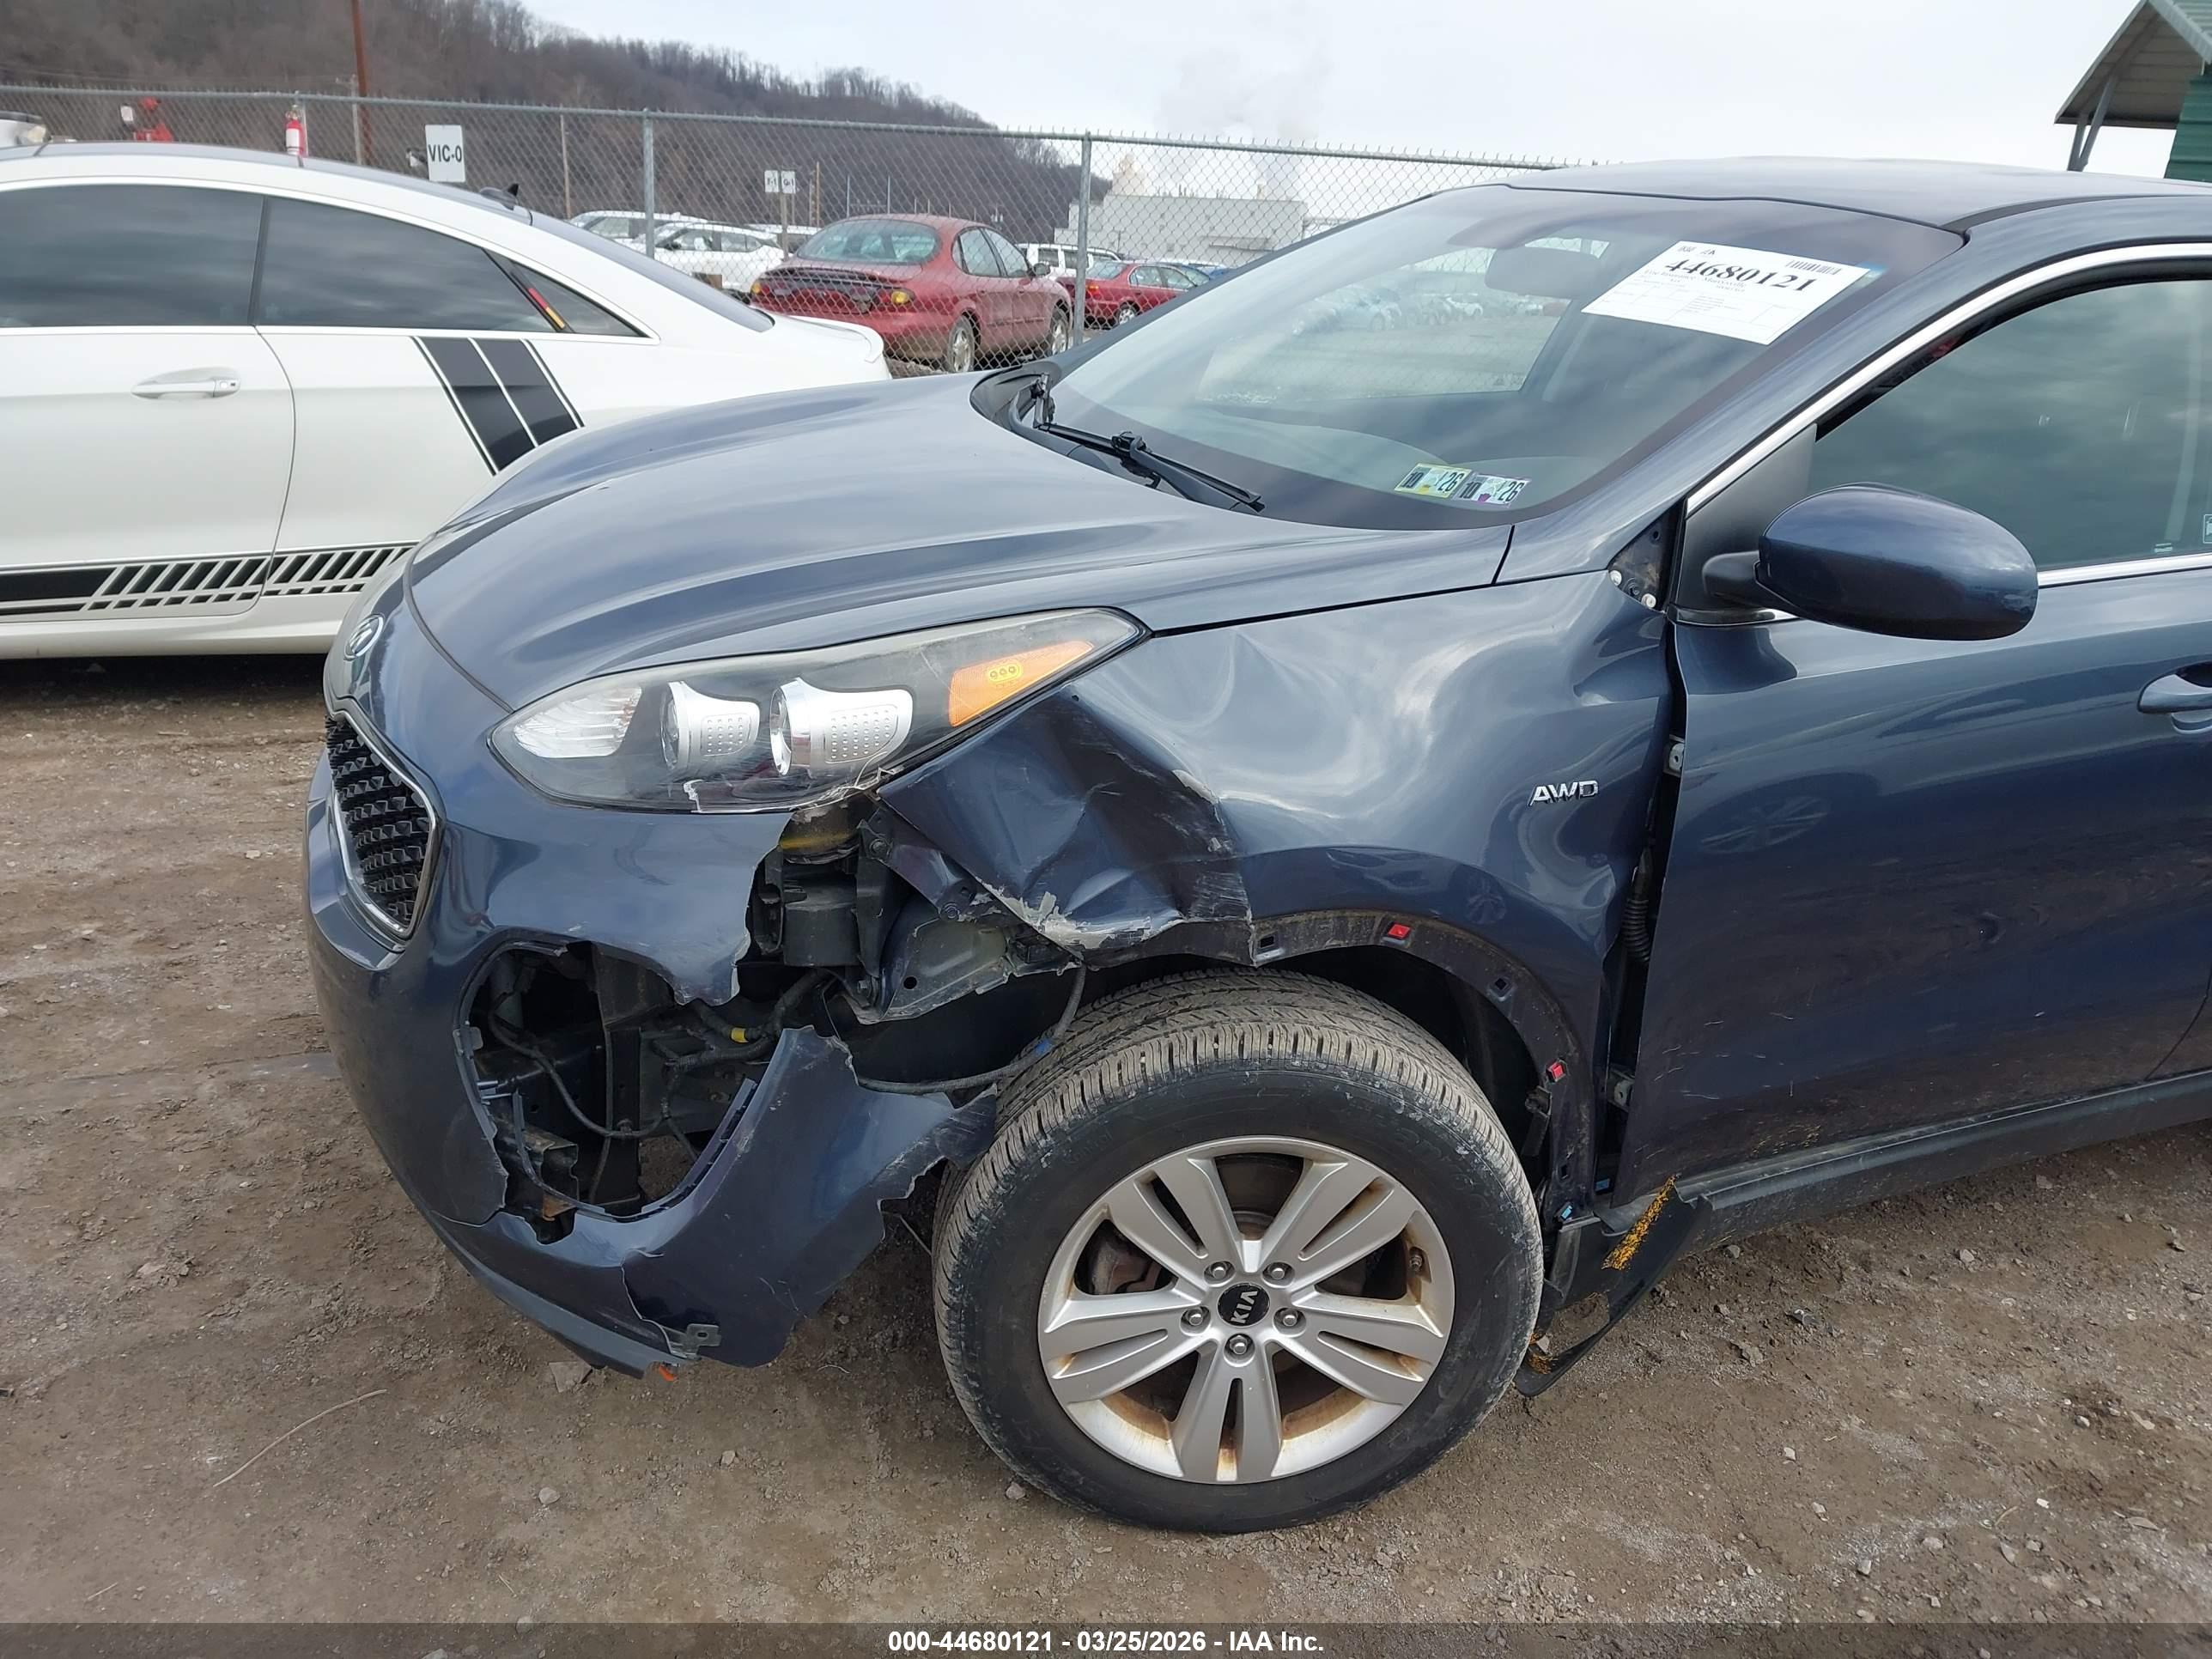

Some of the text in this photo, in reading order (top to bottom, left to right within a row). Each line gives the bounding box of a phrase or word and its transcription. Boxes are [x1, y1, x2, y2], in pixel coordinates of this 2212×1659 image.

[1665, 258, 1817, 291] 44680121
[1459, 481, 1482, 499] 10
[1528, 781, 1599, 806] AWD
[1231, 1290, 1258, 1324] KIA
